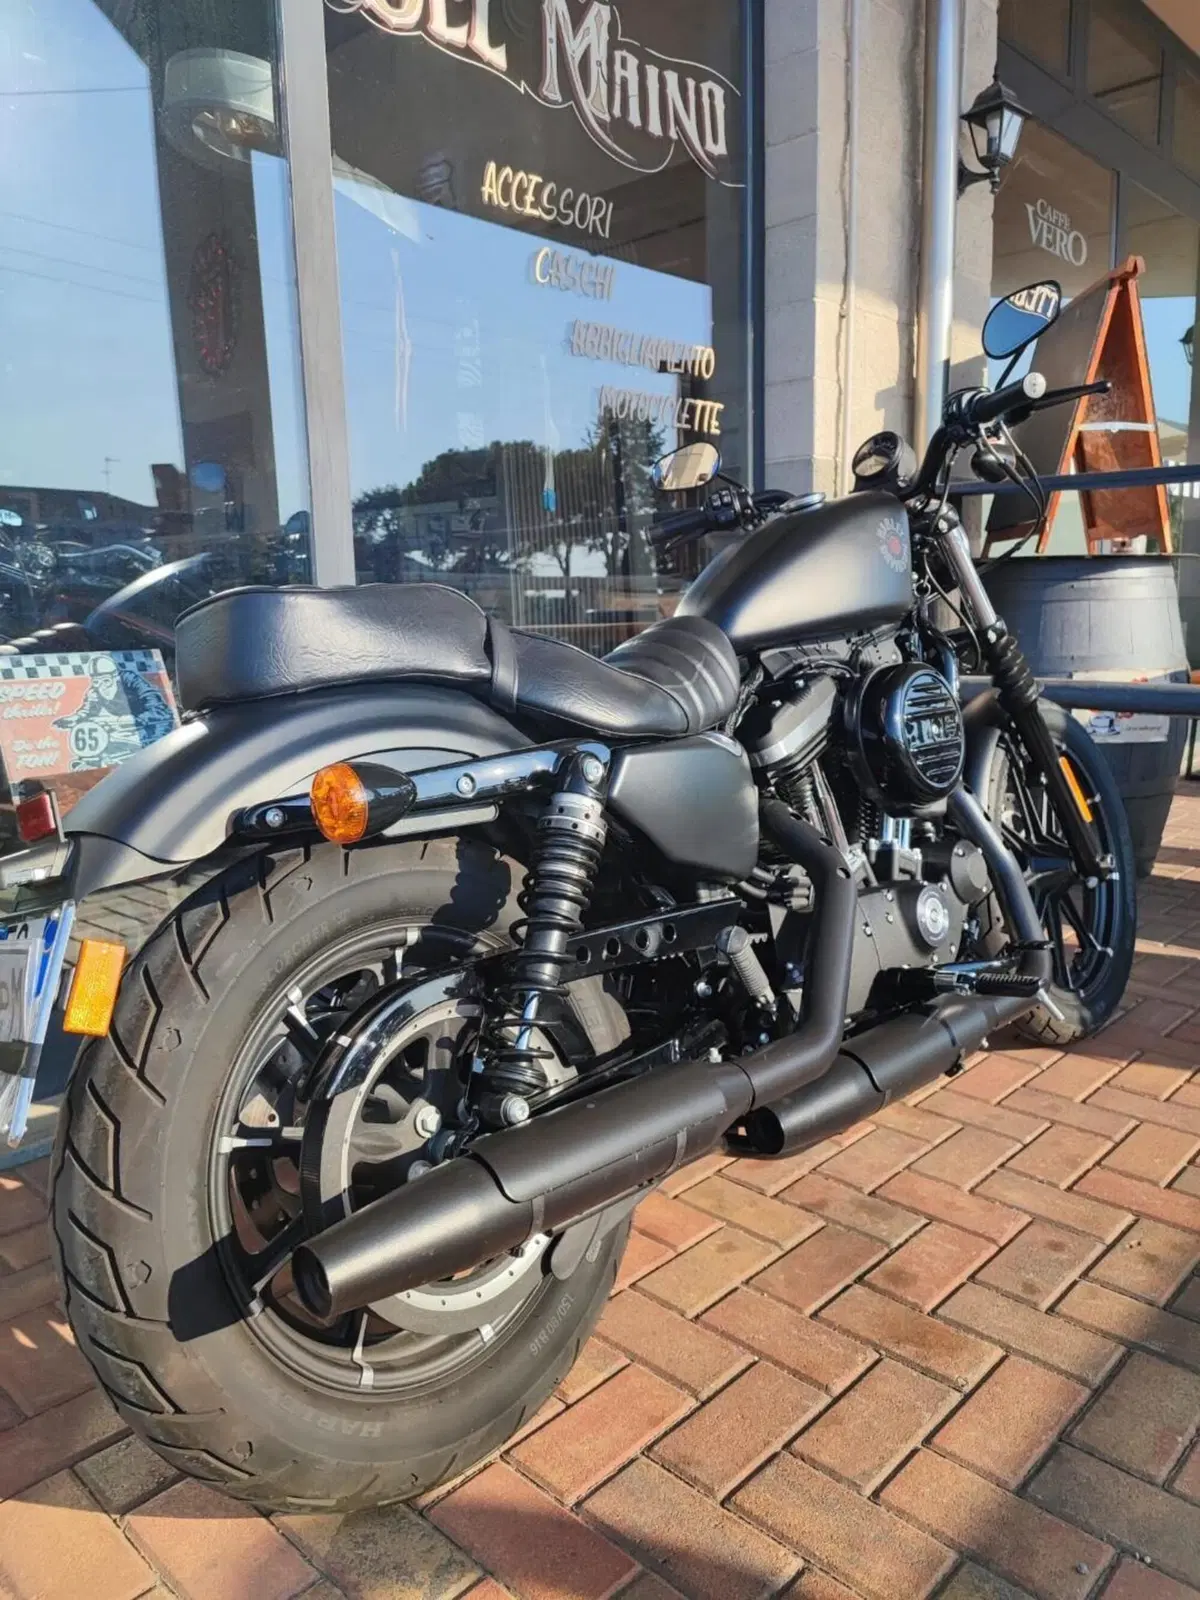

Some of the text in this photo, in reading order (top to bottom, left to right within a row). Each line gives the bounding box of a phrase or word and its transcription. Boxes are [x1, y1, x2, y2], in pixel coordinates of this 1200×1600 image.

[481, 160, 614, 239] ACCESSORI
[1023, 203, 1088, 266] VERO
[74, 727, 99, 751] 65
